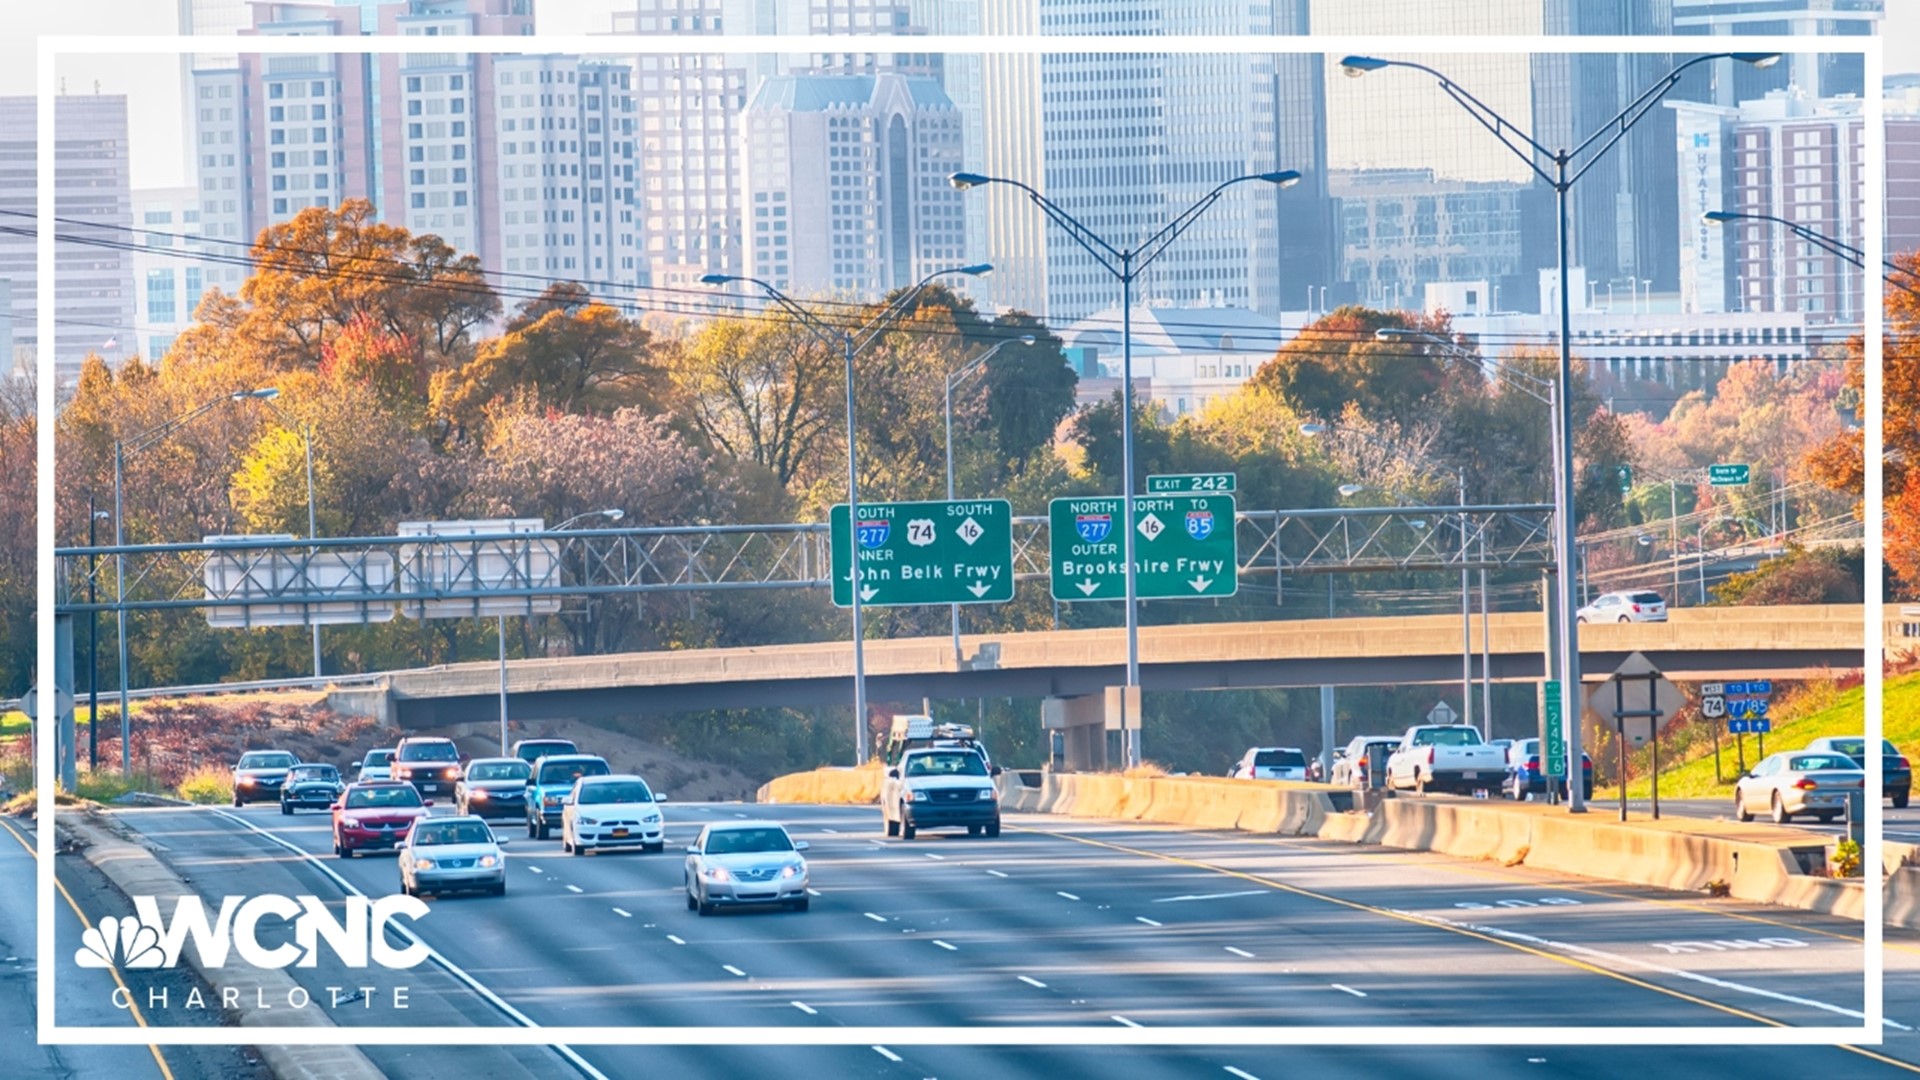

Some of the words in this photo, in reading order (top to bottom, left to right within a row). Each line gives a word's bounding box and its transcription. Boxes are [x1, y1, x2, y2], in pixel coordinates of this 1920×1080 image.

[1698, 153, 1708, 213] HYATT
[1155, 479, 1181, 489] EXIT
[1191, 477, 1228, 490] 242
[947, 504, 993, 516] SOUTH
[1070, 502, 1117, 513] NORTH
[1190, 499, 1208, 510] TO
[848, 507, 895, 519] OUTH
[910, 525, 932, 540] 74
[964, 524, 978, 537] 16
[1081, 523, 1107, 537] 277
[1145, 521, 1159, 533] 16
[1188, 518, 1211, 534] 85
[860, 529, 886, 543] 277
[858, 549, 894, 561] NNER
[1072, 544, 1117, 555] OUTER
[901, 565, 943, 579] Belk
[954, 563, 1001, 580] Frwy
[1177, 557, 1224, 574] Frwy
[1731, 684, 1743, 692] TO
[1753, 684, 1765, 692] TO
[1705, 700, 1722, 713] 74
[1729, 701, 1746, 713] 77
[1751, 700, 1768, 713] 85
[1550, 712, 1559, 754] 242
[1554, 760, 1562, 772] 6
[1652, 937, 1810, 954] ONLY
